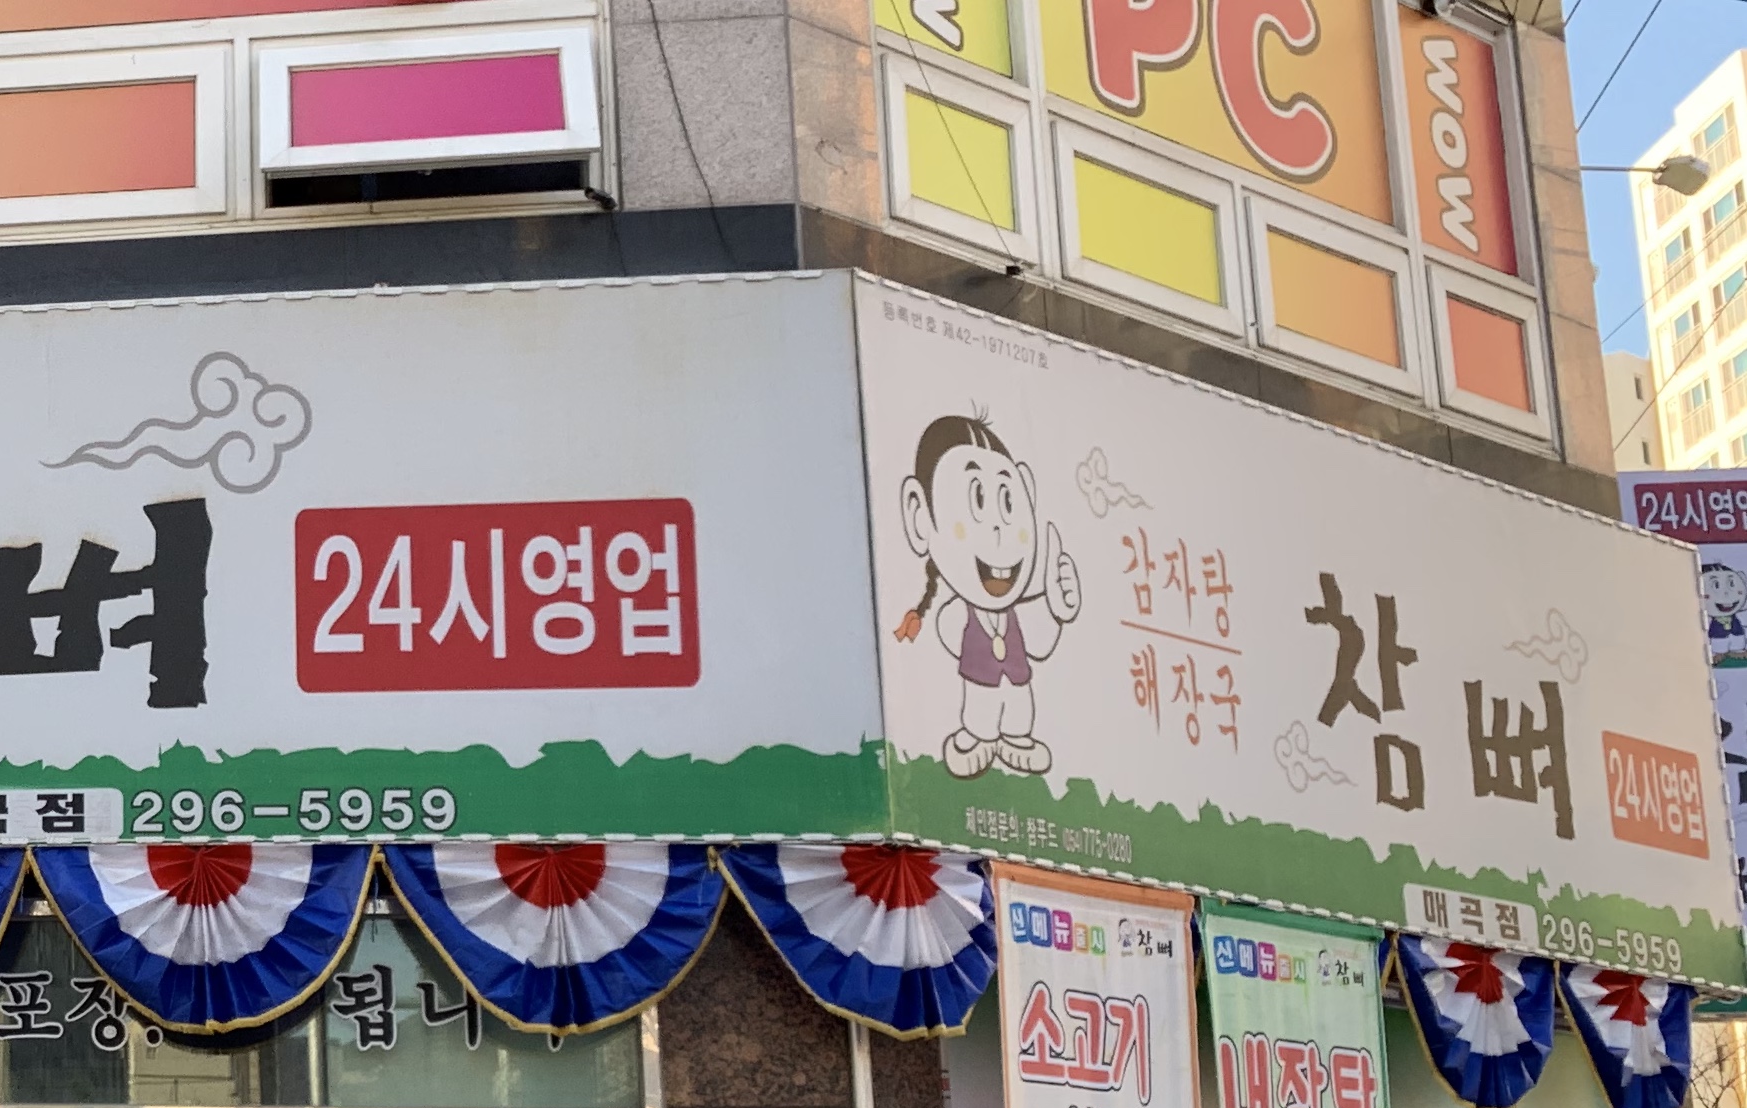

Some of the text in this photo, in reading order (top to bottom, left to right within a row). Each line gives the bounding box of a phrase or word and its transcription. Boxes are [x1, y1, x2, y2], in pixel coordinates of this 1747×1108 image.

[1080, 0, 1337, 183] PC
[1422, 36, 1480, 253] WOW
[883, 300, 1050, 370] 등록번호 제42-1971207호
[1641, 489, 1747, 533] 24시영
[311, 524, 683, 659] 24시영업
[1121, 526, 1234, 638] 감자탕
[1130, 643, 1242, 755] 해장국
[131, 786, 457, 834] 296-5959
[1026, 817, 1059, 849] 참푸드
[1609, 747, 1704, 840] 24시영업
[1010, 905, 1071, 947] 신메뉴
[1137, 929, 1173, 958] 참뼈
[1215, 938, 1275, 978] 신메뉴
[1422, 889, 1683, 973] 매곡점 296-5959
[329, 963, 563, 1052] 됩니
[1018, 981, 1151, 1106] 소고기
